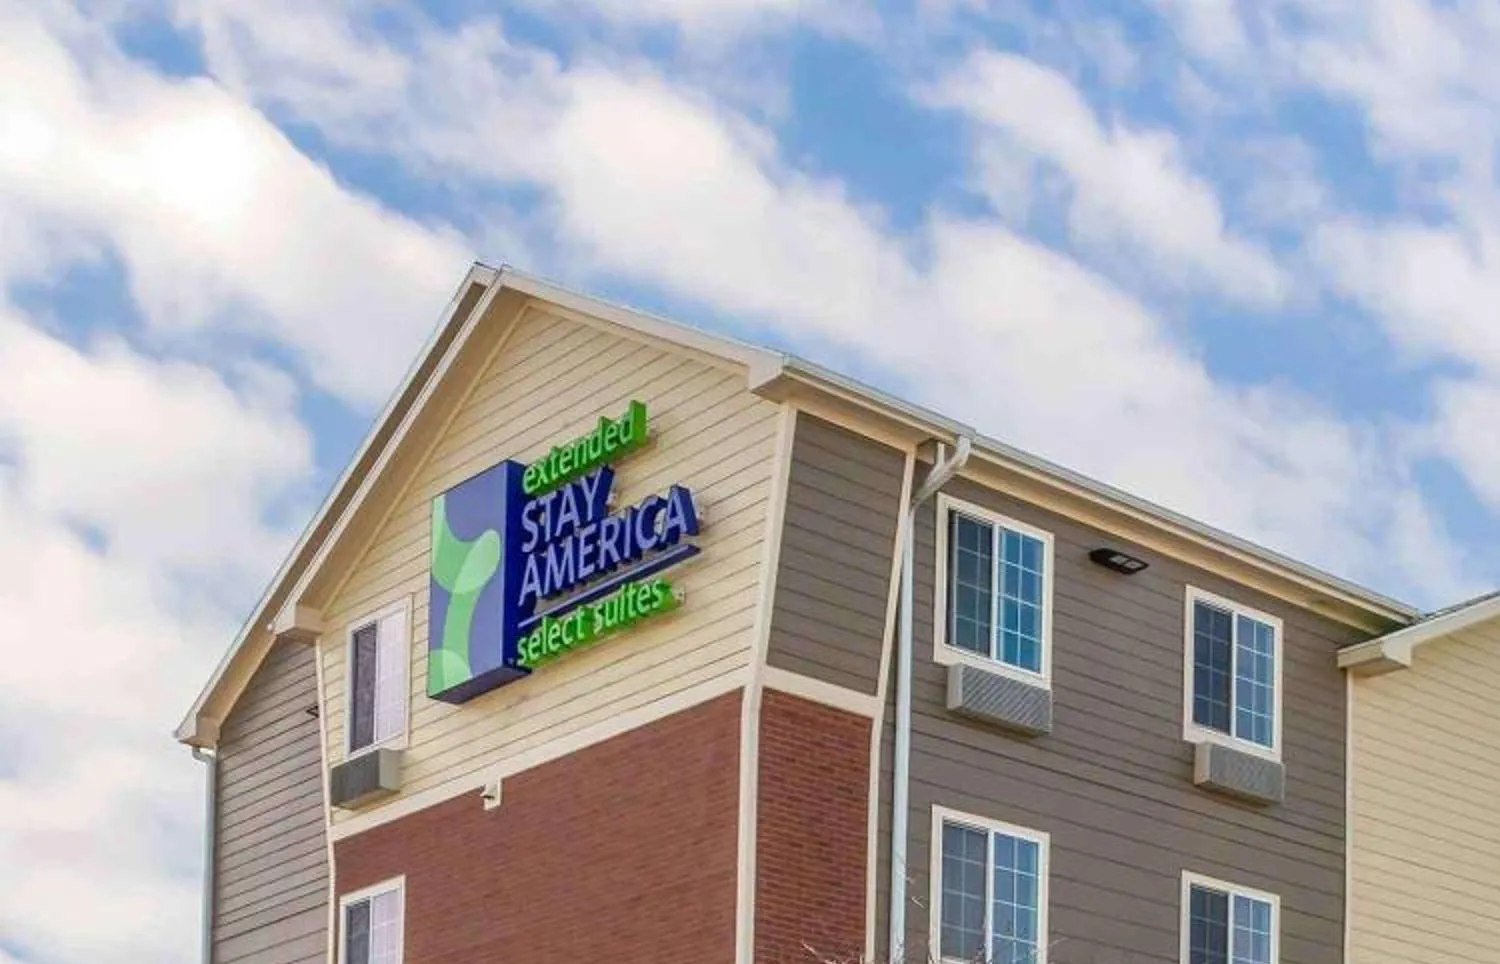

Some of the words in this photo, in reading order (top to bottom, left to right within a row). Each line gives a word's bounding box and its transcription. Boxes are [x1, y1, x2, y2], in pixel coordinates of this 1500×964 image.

[521, 400, 640, 495] extended
[518, 484, 691, 607] AMERICA
[521, 466, 608, 553] STAY
[516, 608, 588, 666] select
[592, 577, 668, 633] suites
